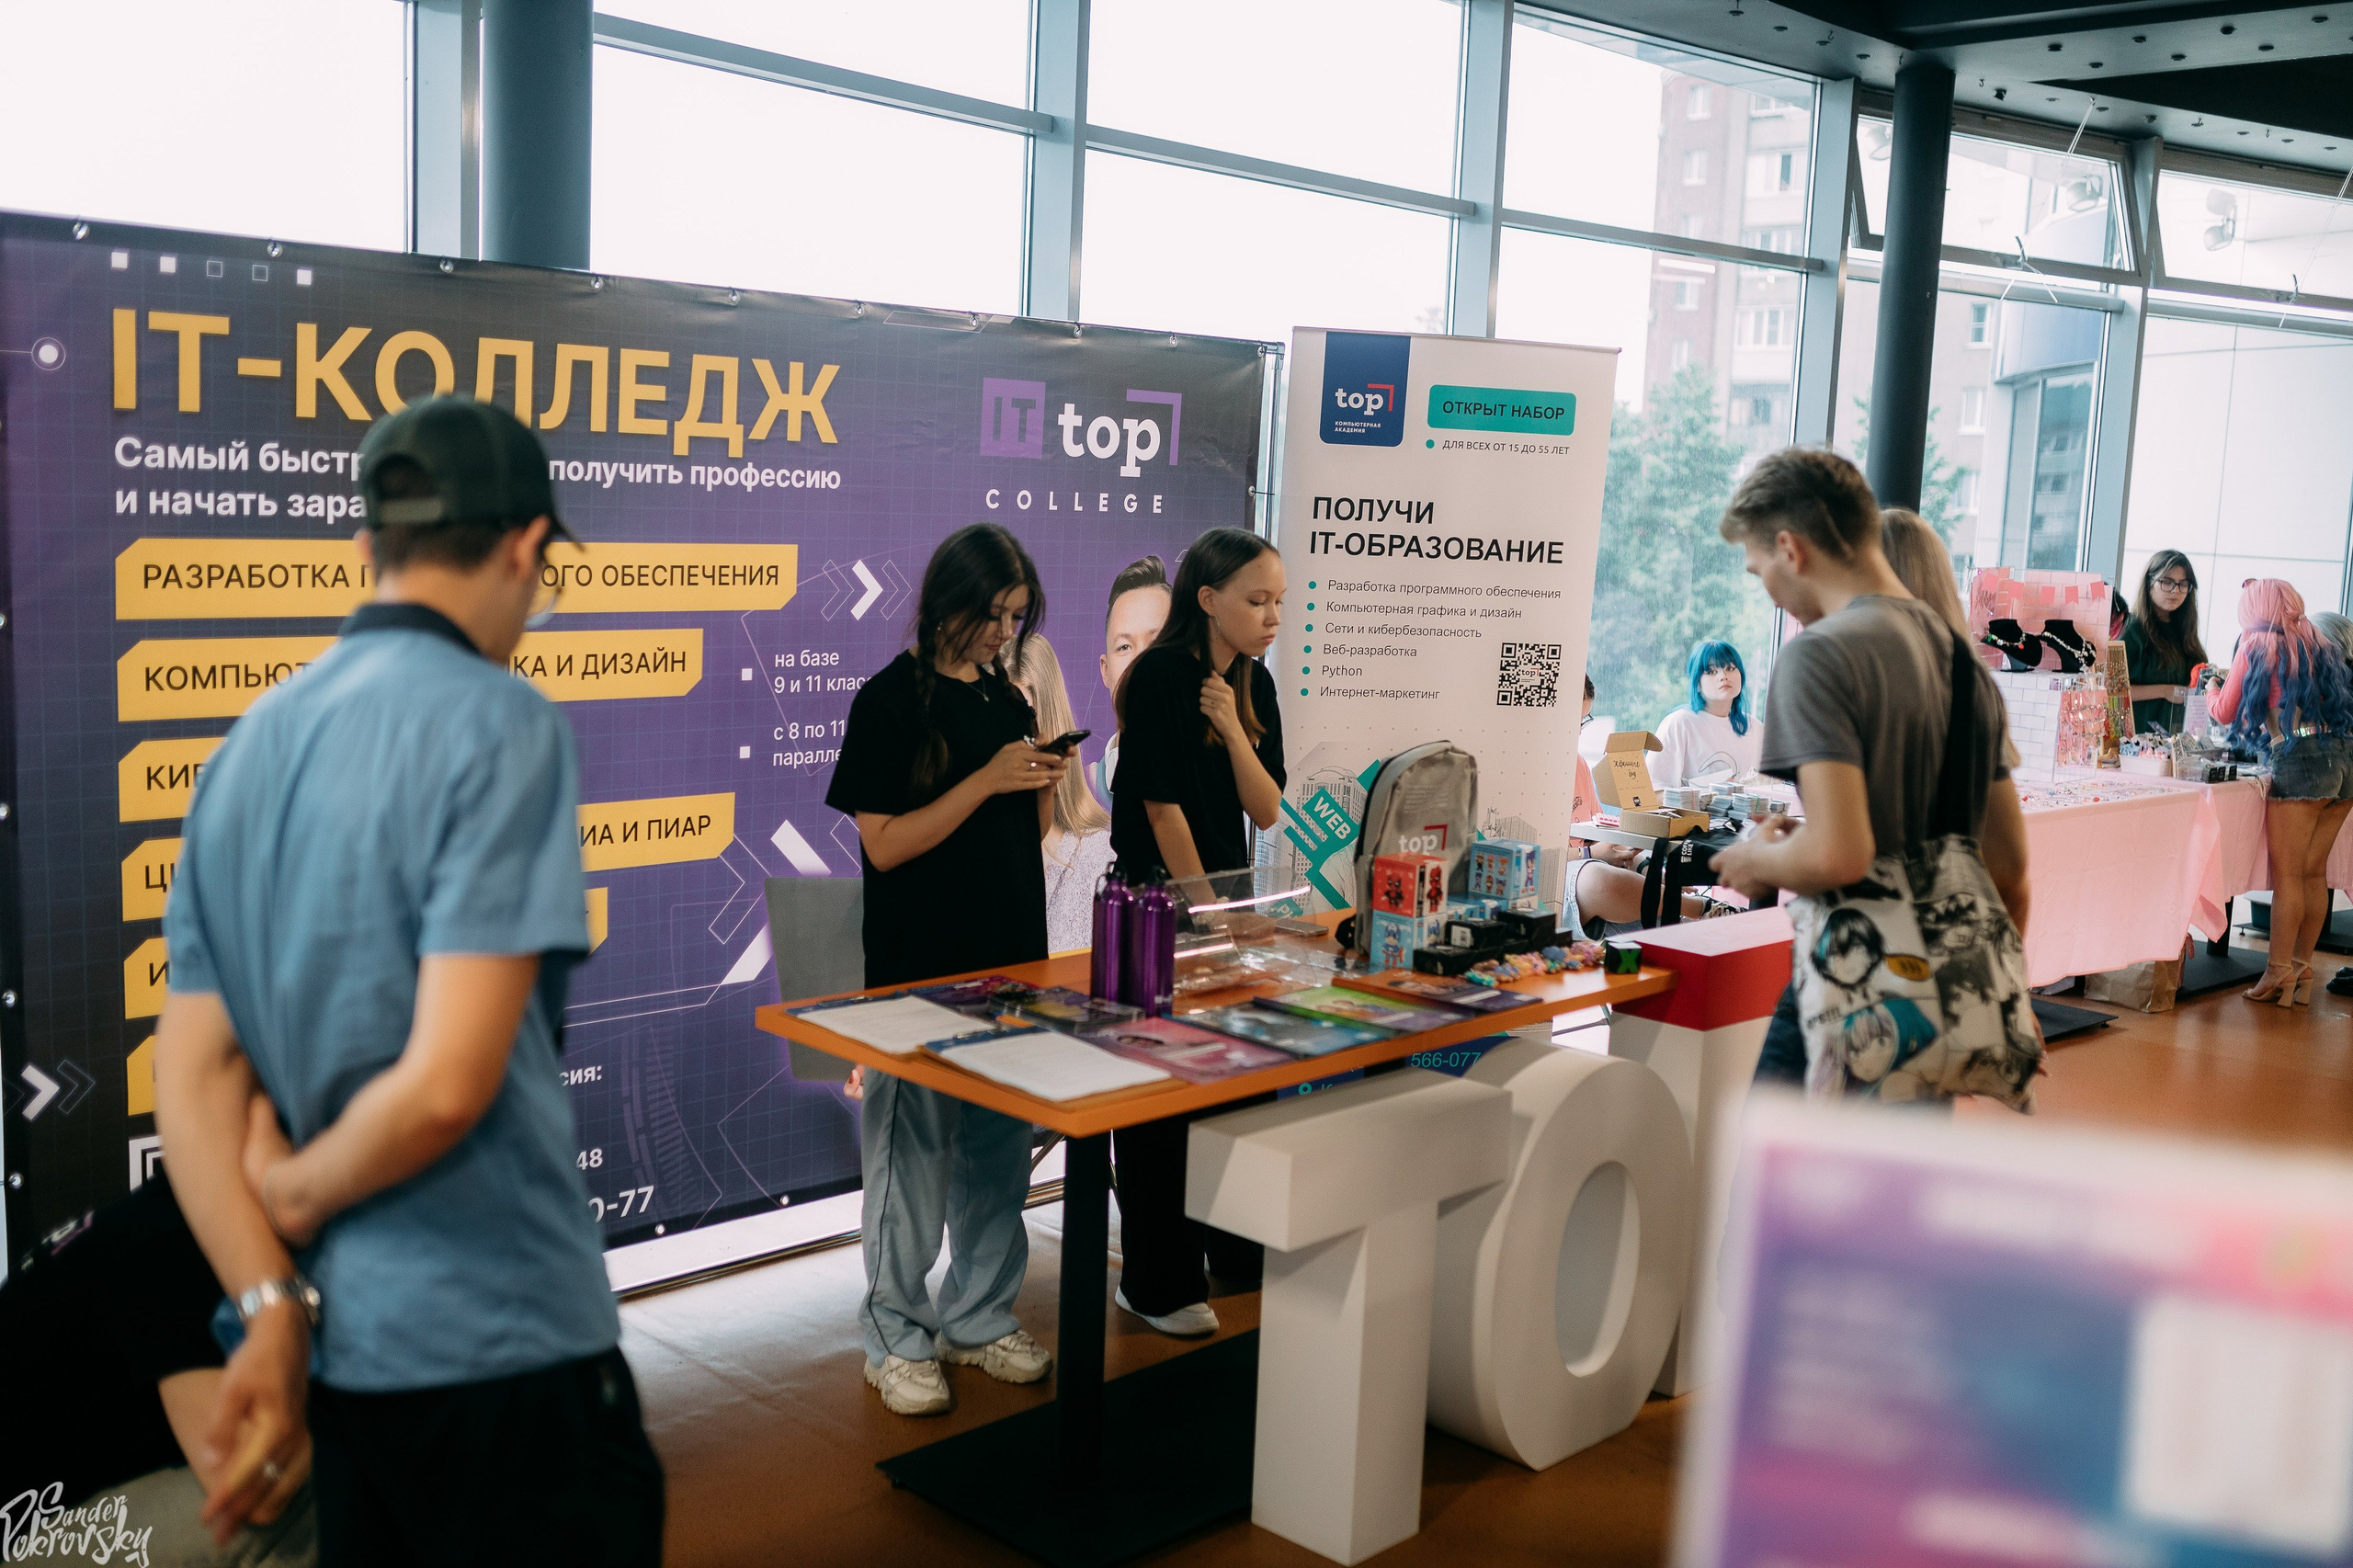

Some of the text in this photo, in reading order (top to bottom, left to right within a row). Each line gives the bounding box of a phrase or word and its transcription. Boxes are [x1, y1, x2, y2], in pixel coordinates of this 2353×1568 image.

[113, 308, 840, 458] IT-КОЛЛЕДЖ
[1335, 388, 1384, 415] top
[1442, 401, 1565, 420] ОТКРЫТ НАБОР
[992, 396, 1161, 477] IT top
[1442, 439, 1570, 455] ДЛЯ ВСЕХ ОТ 15 ДО 55 ЛЕТ
[114, 437, 249, 471] Самый
[548, 460, 683, 489] получить
[689, 462, 841, 493] профессию
[115, 490, 137, 514] и
[148, 491, 278, 516] начать
[985, 488, 1163, 514] COLLEGE
[1312, 495, 1435, 525] ПОЛУЧИ
[1310, 530, 1564, 564] IT-ОБРАЗОВАНИЕ
[143, 563, 350, 589] РАЗРАБОТКА
[601, 563, 779, 587] ОБЕСПЕЧЕНИЯ
[1328, 579, 1562, 599] Разработка программного обеспечения
[1326, 601, 1522, 619] Компьютерная графика и дизайн
[1324, 622, 1483, 639] Сети и кибербезопасность
[774, 649, 840, 668] на базе
[1323, 643, 1417, 658] Веб-разработка
[508, 646, 687, 681] КА И ДИЗАЙН
[1321, 665, 1363, 678] Python
[1521, 669, 1536, 677] top
[774, 676, 786, 694] 9
[790, 679, 801, 693] и
[805, 675, 821, 692] 11
[1320, 686, 1440, 700] Интернет-маркетинг
[773, 719, 846, 741] с 8 по 11
[622, 821, 639, 844] И
[647, 814, 711, 841] ПИАР
[1313, 796, 1351, 840] WEB
[1398, 835, 1438, 856] top
[1411, 1051, 1481, 1068] 566-077
